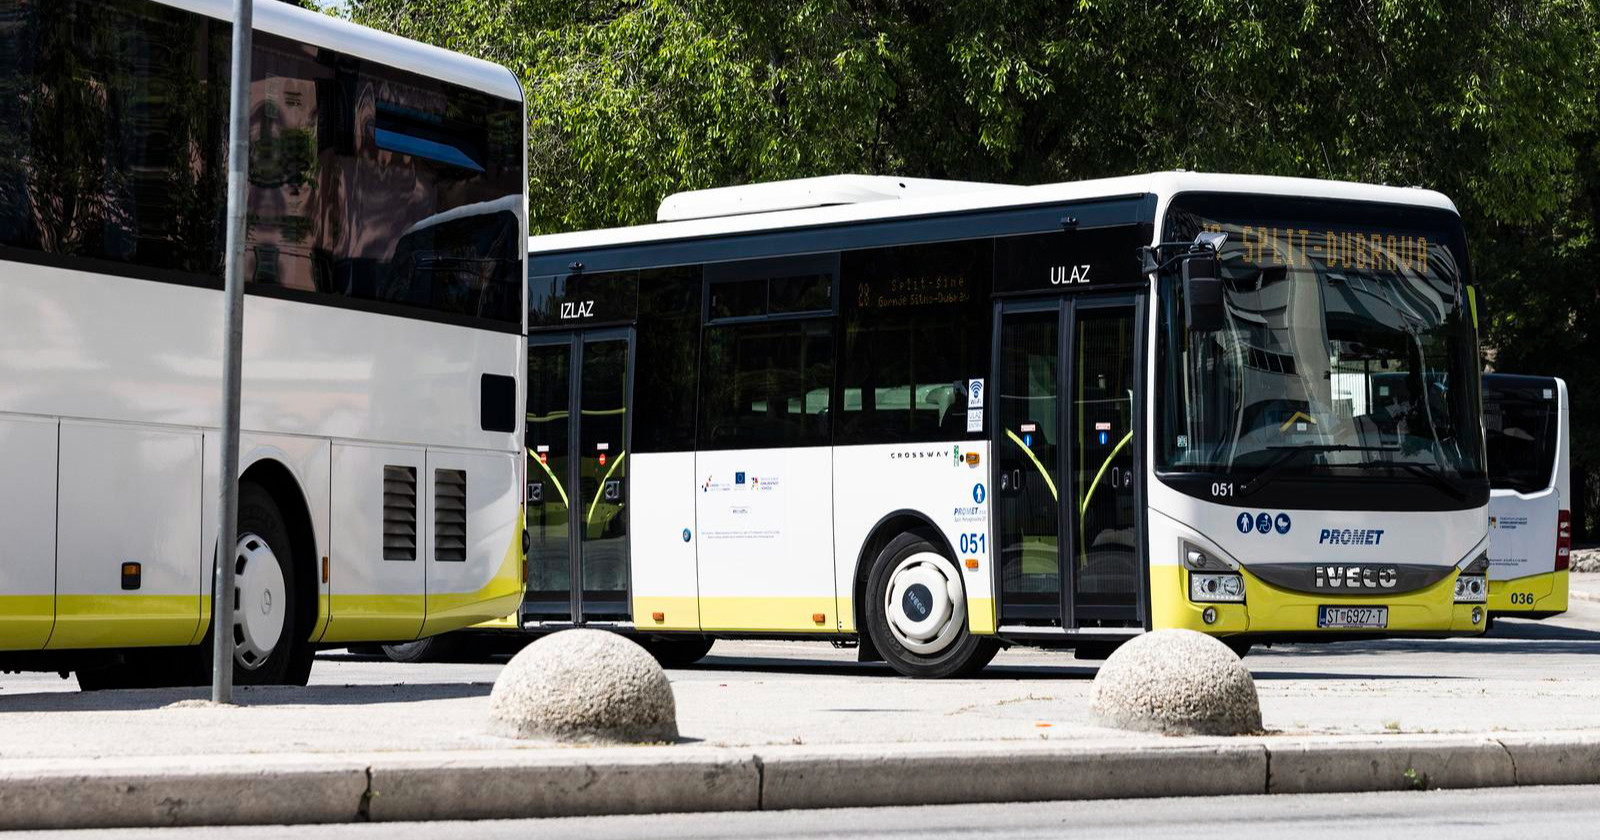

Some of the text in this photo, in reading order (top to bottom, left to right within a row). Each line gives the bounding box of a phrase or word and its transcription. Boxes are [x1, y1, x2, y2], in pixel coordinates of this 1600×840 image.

[1243, 225, 1427, 273] SPLIT-DUBRAVA
[1051, 265, 1090, 284] ULAZ
[561, 301, 594, 319] IZLAZ
[890, 451, 948, 459] CROSSWAY
[1211, 482, 1234, 497] 051
[954, 507, 978, 516] PROMET
[960, 533, 985, 554] 051
[1319, 529, 1384, 545] PROMET
[1315, 566, 1397, 588] IVECO
[908, 591, 926, 615] IVECO
[1510, 593, 1534, 605] 036
[1327, 609, 1340, 623] ST
